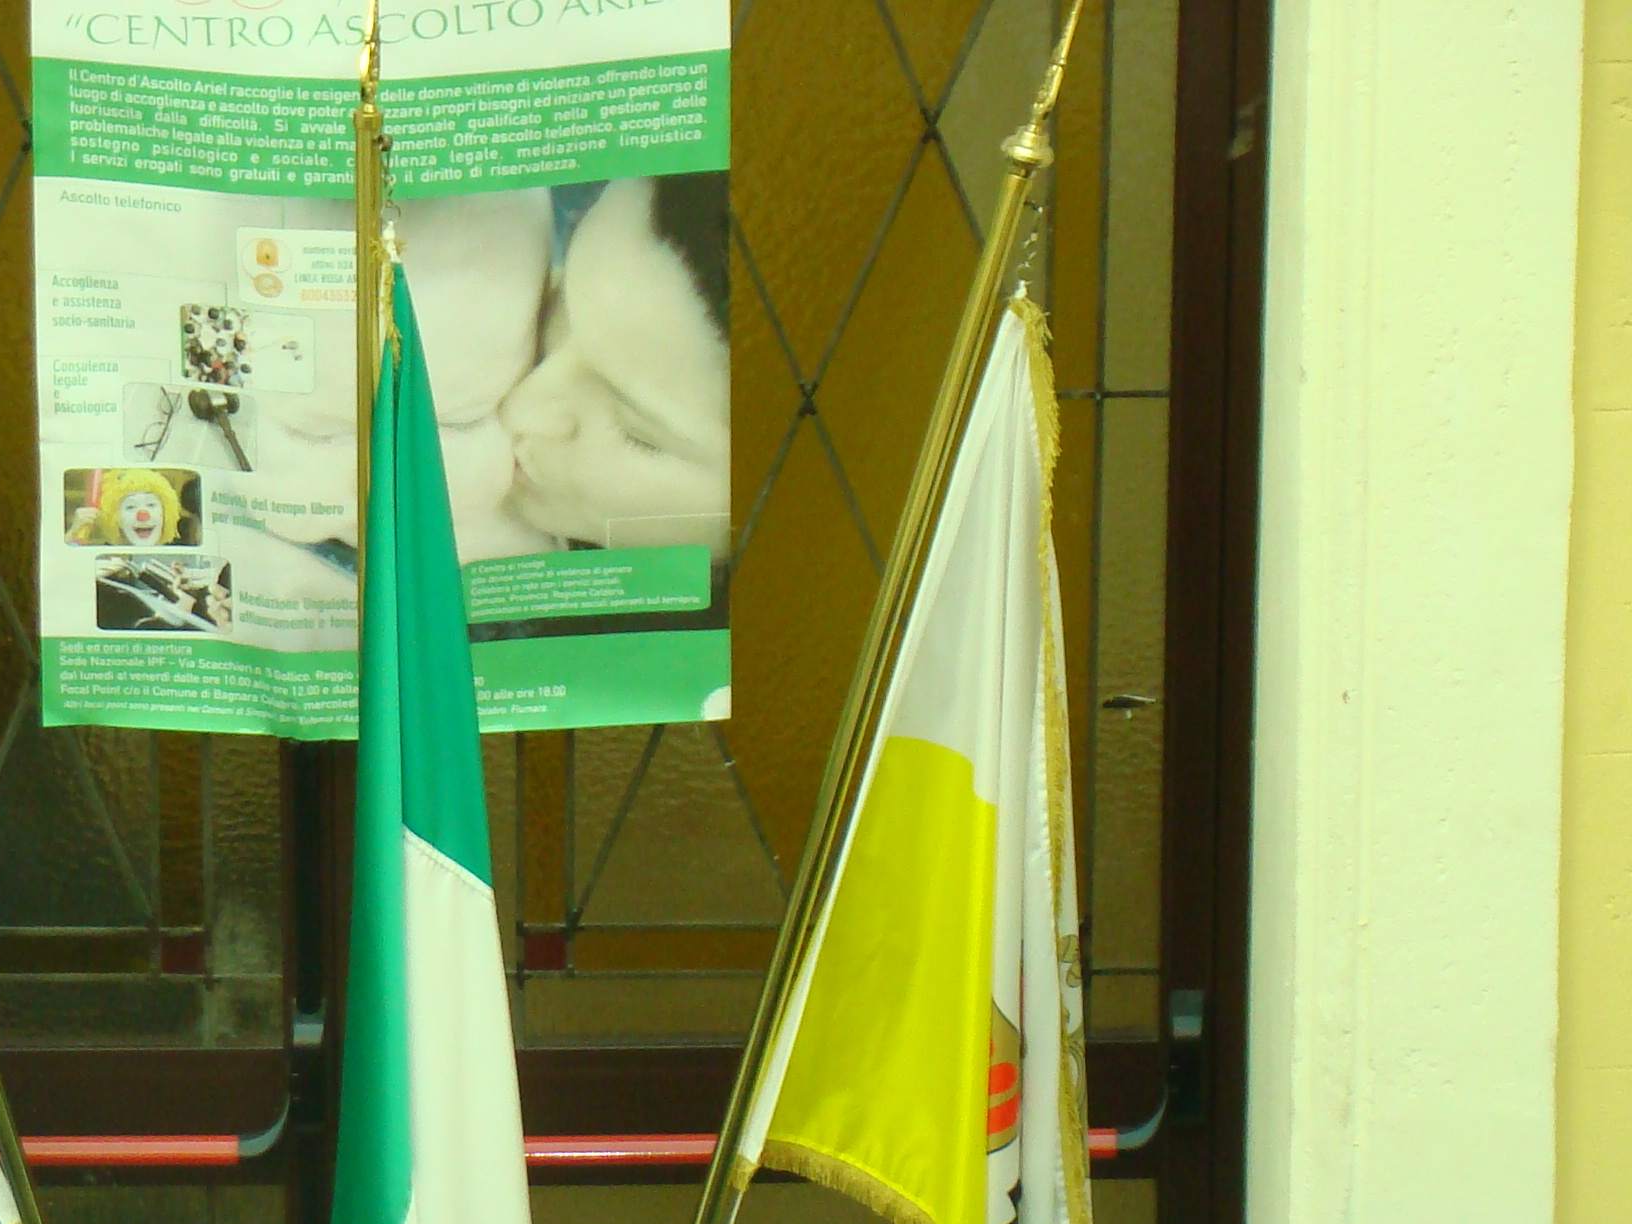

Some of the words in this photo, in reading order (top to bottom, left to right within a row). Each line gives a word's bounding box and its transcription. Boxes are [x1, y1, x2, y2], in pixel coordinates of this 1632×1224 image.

[308, 0, 544, 46] ASCOLTO
[69, 68, 77, 82] Il
[80, 69, 125, 87] Centro
[128, 74, 191, 93] d'Ascolto
[195, 80, 227, 96] Ariel
[230, 85, 294, 102] raccoglie
[297, 87, 310, 100] le
[313, 89, 377, 104] esigen
[381, 89, 416, 103] delle
[419, 86, 462, 100] donne
[464, 81, 514, 96] vittime
[516, 79, 529, 93] di
[597, 67, 656, 84] offrendo
[659, 64, 687, 77] loro
[689, 63, 708, 75] un
[69, 85, 108, 102] luogo
[111, 88, 123, 101] di
[125, 92, 206, 111] accoglienza
[208, 101, 217, 112] e
[219, 102, 269, 115] ascolto
[272, 103, 305, 116] dove
[308, 105, 346, 120] poter
[432, 100, 475, 118] propri
[478, 95, 531, 112] bisogni
[533, 96, 551, 109] ed
[554, 90, 605, 105] iniziare
[607, 88, 625, 99] un
[628, 81, 692, 99] percorso
[694, 78, 708, 91] di
[70, 101, 143, 120] fuoriuscita
[154, 110, 188, 125] dalla
[274, 118, 289, 132] Si
[300, 121, 347, 134] avvale
[467, 113, 542, 131] qualificato
[554, 107, 588, 122] nella
[599, 99, 661, 119] gestione
[672, 95, 708, 109] delle
[70, 119, 169, 139] problematiche
[172, 127, 214, 144] legate
[217, 132, 242, 147] alla
[245, 135, 304, 150] violenza
[306, 139, 316, 150] e
[318, 137, 332, 150] al
[454, 132, 488, 147] Offre
[492, 129, 542, 144] ascolto
[70, 135, 140, 153] sostegno
[153, 143, 238, 163] psicologico
[250, 153, 260, 164] e
[517, 138, 607, 158] mediazione
[82, 153, 128, 168] servizi
[134, 157, 183, 174] erogati
[188, 164, 223, 177] sono
[229, 168, 280, 182] gratuiti
[287, 171, 296, 182] e
[405, 170, 413, 183] il
[420, 167, 463, 182] diritto
[470, 164, 483, 178] di
[490, 158, 580, 176] riservatezza.
[61, 190, 110, 206] Ascolto
[114, 195, 181, 213] telefonico
[52, 275, 119, 291] Accoglienza
[53, 298, 59, 307] e
[63, 297, 122, 309] assistenza
[53, 316, 136, 329] socio-sanitaria
[53, 359, 119, 373] Consulenza
[53, 375, 88, 388] legale
[54, 390, 60, 399] e
[54, 401, 117, 415] psicologica
[251, 498, 268, 511] del
[271, 501, 306, 516] tempo
[310, 502, 344, 515] libero
[59, 641, 84, 655] Sedi
[86, 642, 100, 654] ed
[103, 643, 129, 655] orari
[132, 643, 142, 655] di
[146, 644, 192, 656] apertura
[59, 655, 87, 667] Sede
[90, 656, 145, 668] Nazionale
[178, 658, 195, 669] Via
[315, 669, 354, 683] Reggio
[59, 672, 77, 682] dal
[117, 672, 127, 682] al
[173, 673, 200, 684] dalle
[202, 675, 220, 685] ore
[272, 685, 288, 695] ore
[322, 686, 329, 695] e
[60, 684, 90, 695] Focal
[92, 684, 120, 696] Point
[123, 685, 140, 696] c/o
[152, 685, 198, 699] Comune
[200, 687, 211, 698] di
[214, 689, 258, 703] Bagnara
[516, 690, 535, 699] ore
